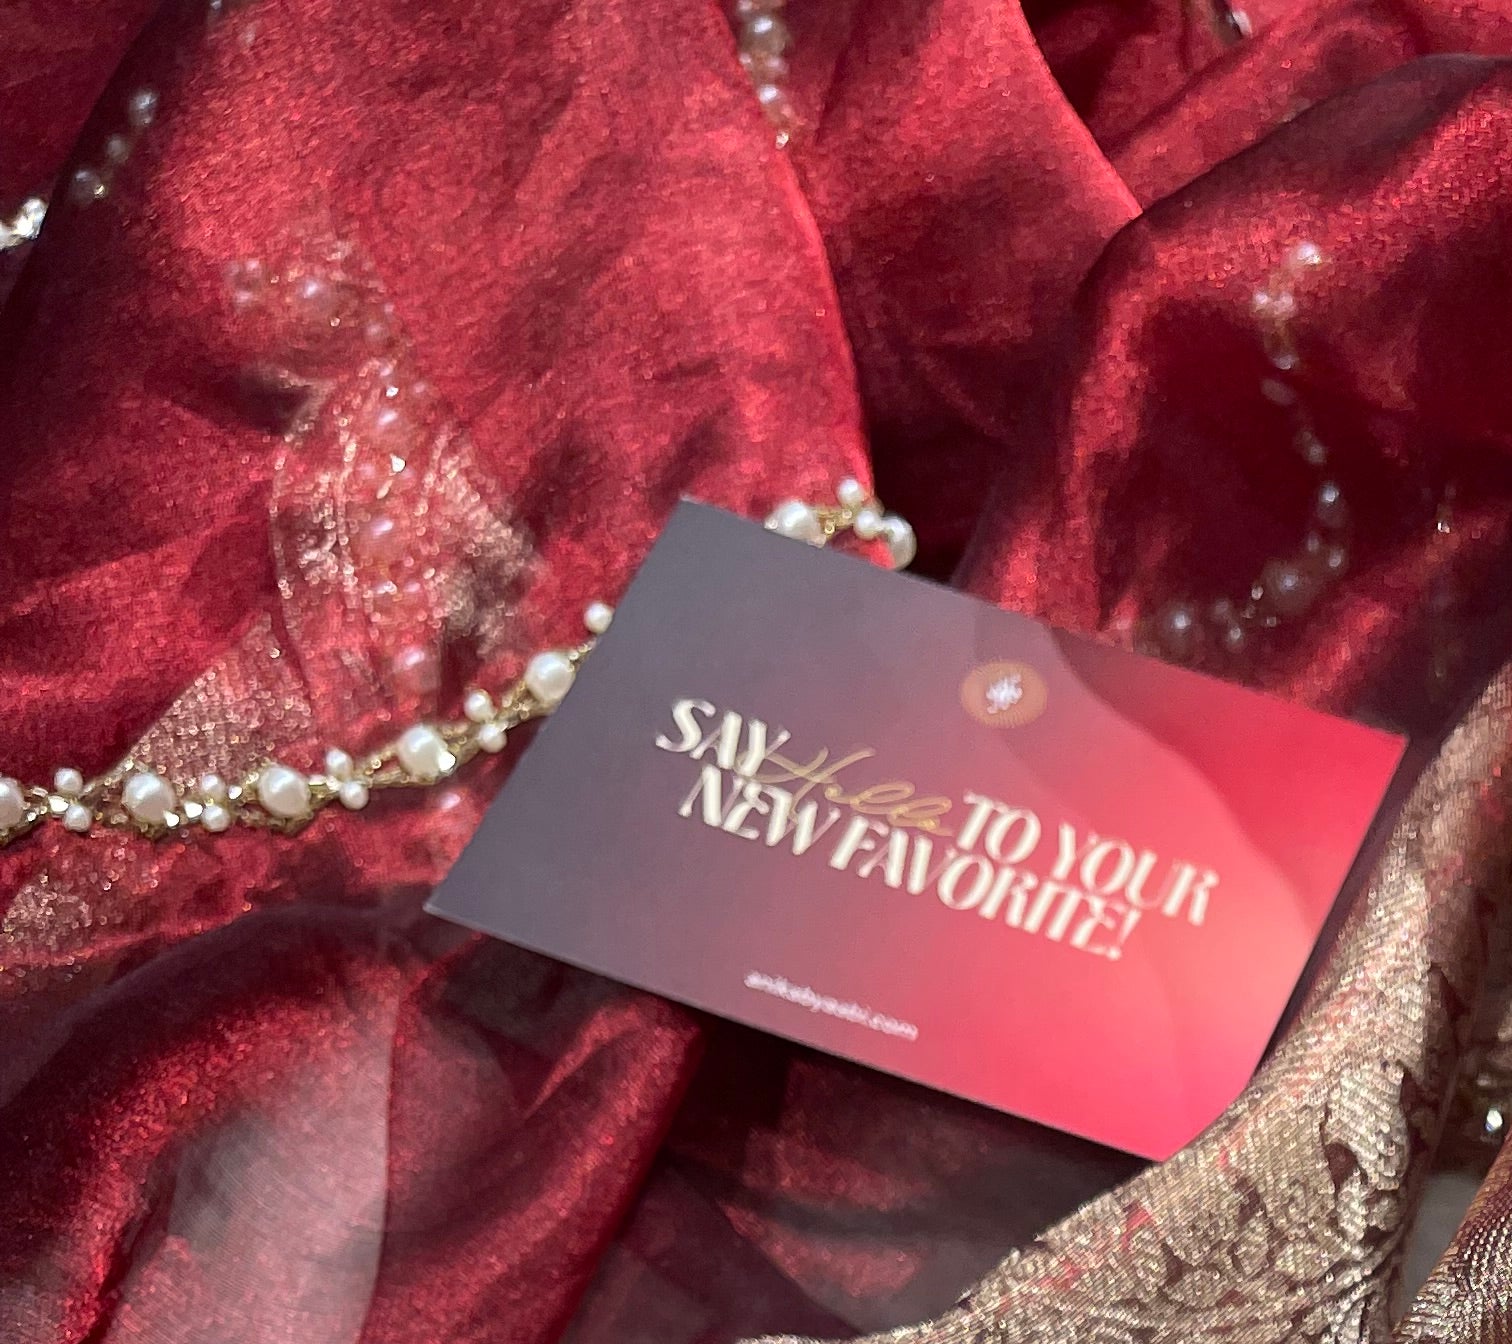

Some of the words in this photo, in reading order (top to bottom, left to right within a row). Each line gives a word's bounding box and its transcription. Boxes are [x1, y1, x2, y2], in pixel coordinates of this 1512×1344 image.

[656, 699, 791, 776] SAY
[963, 789, 1042, 864] TO
[1053, 822, 1219, 925] YOUR
[678, 764, 841, 855] NEW
[829, 814, 1142, 961] FAVORITE!
